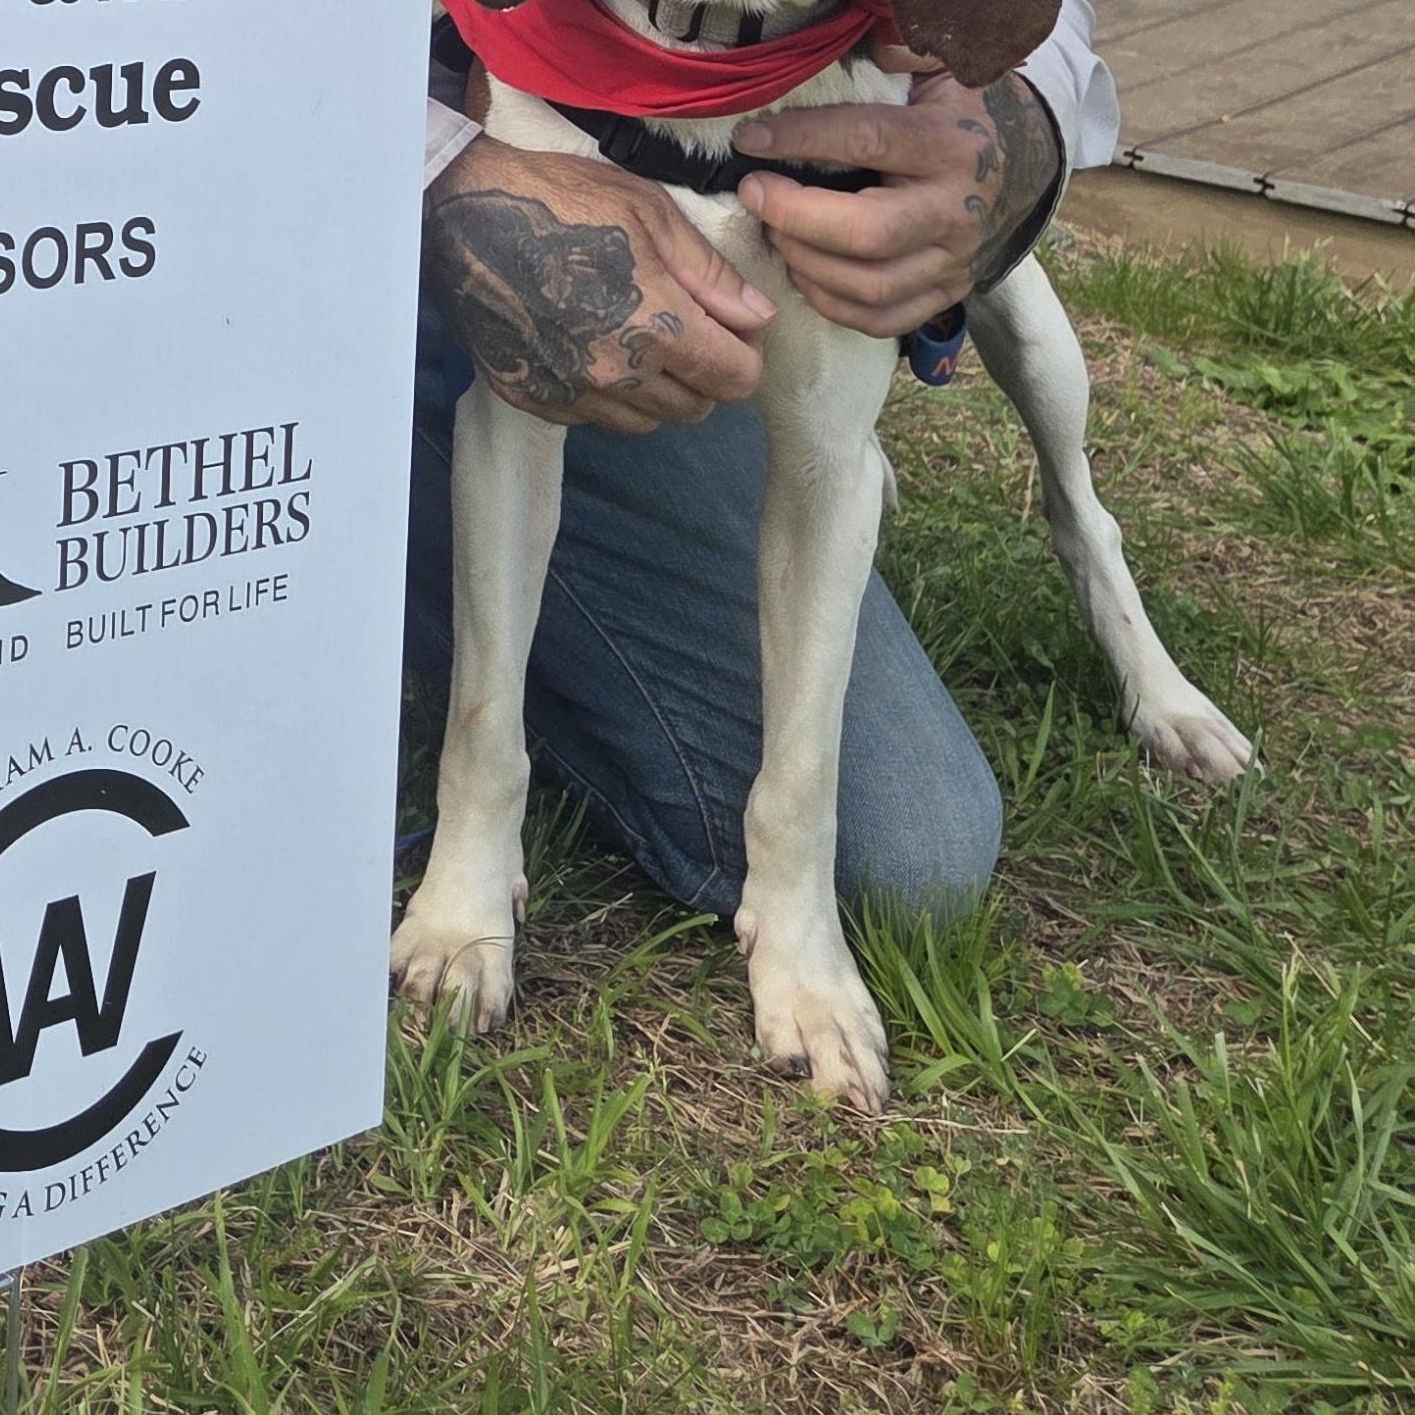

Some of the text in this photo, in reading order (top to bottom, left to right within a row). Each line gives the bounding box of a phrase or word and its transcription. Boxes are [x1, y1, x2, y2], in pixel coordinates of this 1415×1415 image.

[56, 421, 314, 528] BETHEL
[54, 490, 311, 592] BUILDERS
[66, 573, 288, 650] BUILT FOR LIFE
[64, 727, 94, 756] A.
[107, 724, 205, 795] COOKE
[12, 1190, 34, 1219] A
[44, 1046, 208, 1213] DIFFERENCE
